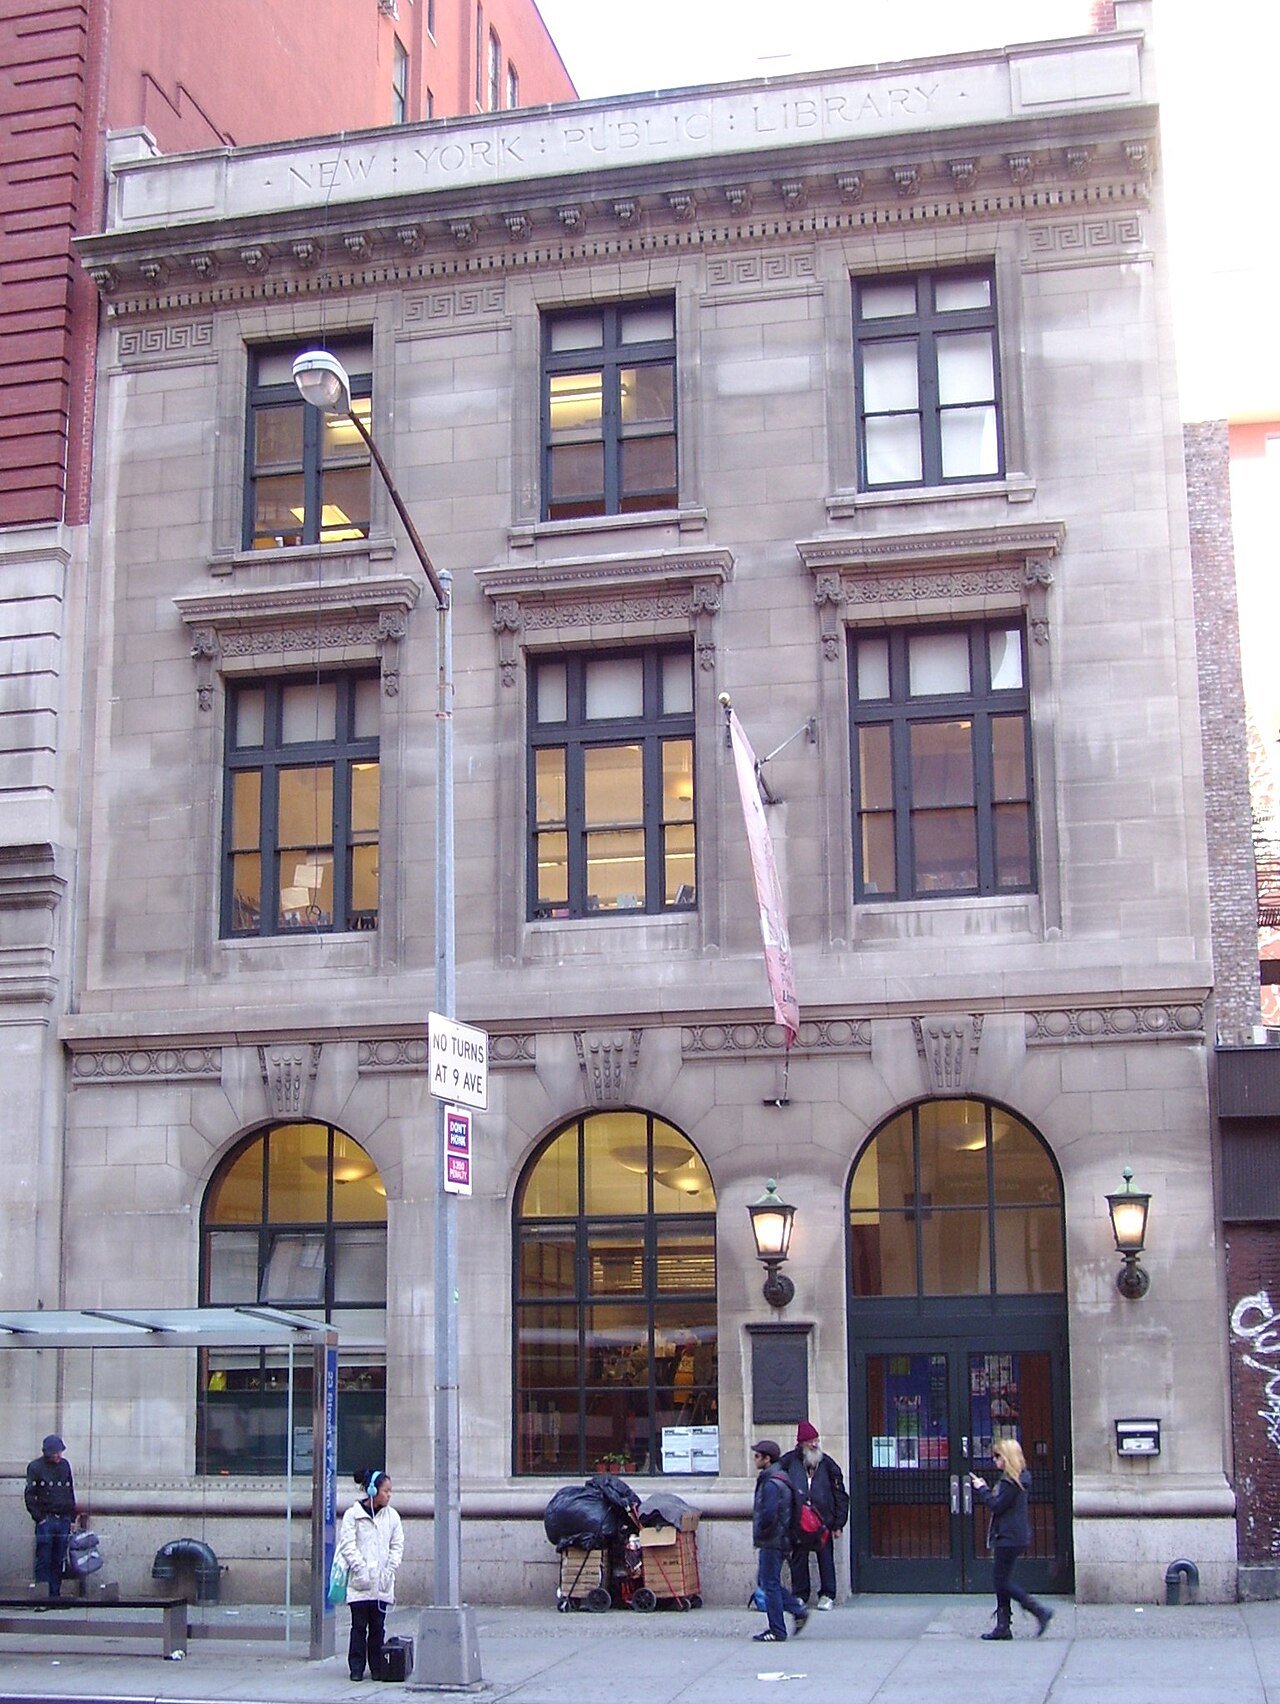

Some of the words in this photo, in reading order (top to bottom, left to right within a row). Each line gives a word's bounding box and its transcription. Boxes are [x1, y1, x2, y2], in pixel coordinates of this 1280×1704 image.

[287, 155, 376, 191] NEW
[414, 136, 525, 175] YORK
[563, 113, 711, 156] PUBLIC
[752, 83, 941, 133] LIBRARY
[433, 1033, 447, 1052] NO
[452, 1037, 484, 1064] TURNS
[435, 1064, 448, 1084] AT
[452, 1069, 460, 1087] 9
[463, 1073, 483, 1094] AVE
[449, 1121, 467, 1135] DON'T
[450, 1133, 466, 1147] HONK
[449, 1168, 468, 1180] PENALTY
[327, 1371, 334, 1388] 23
[326, 1392, 334, 1436] Street
[325, 1468, 333, 1521] Avenue
